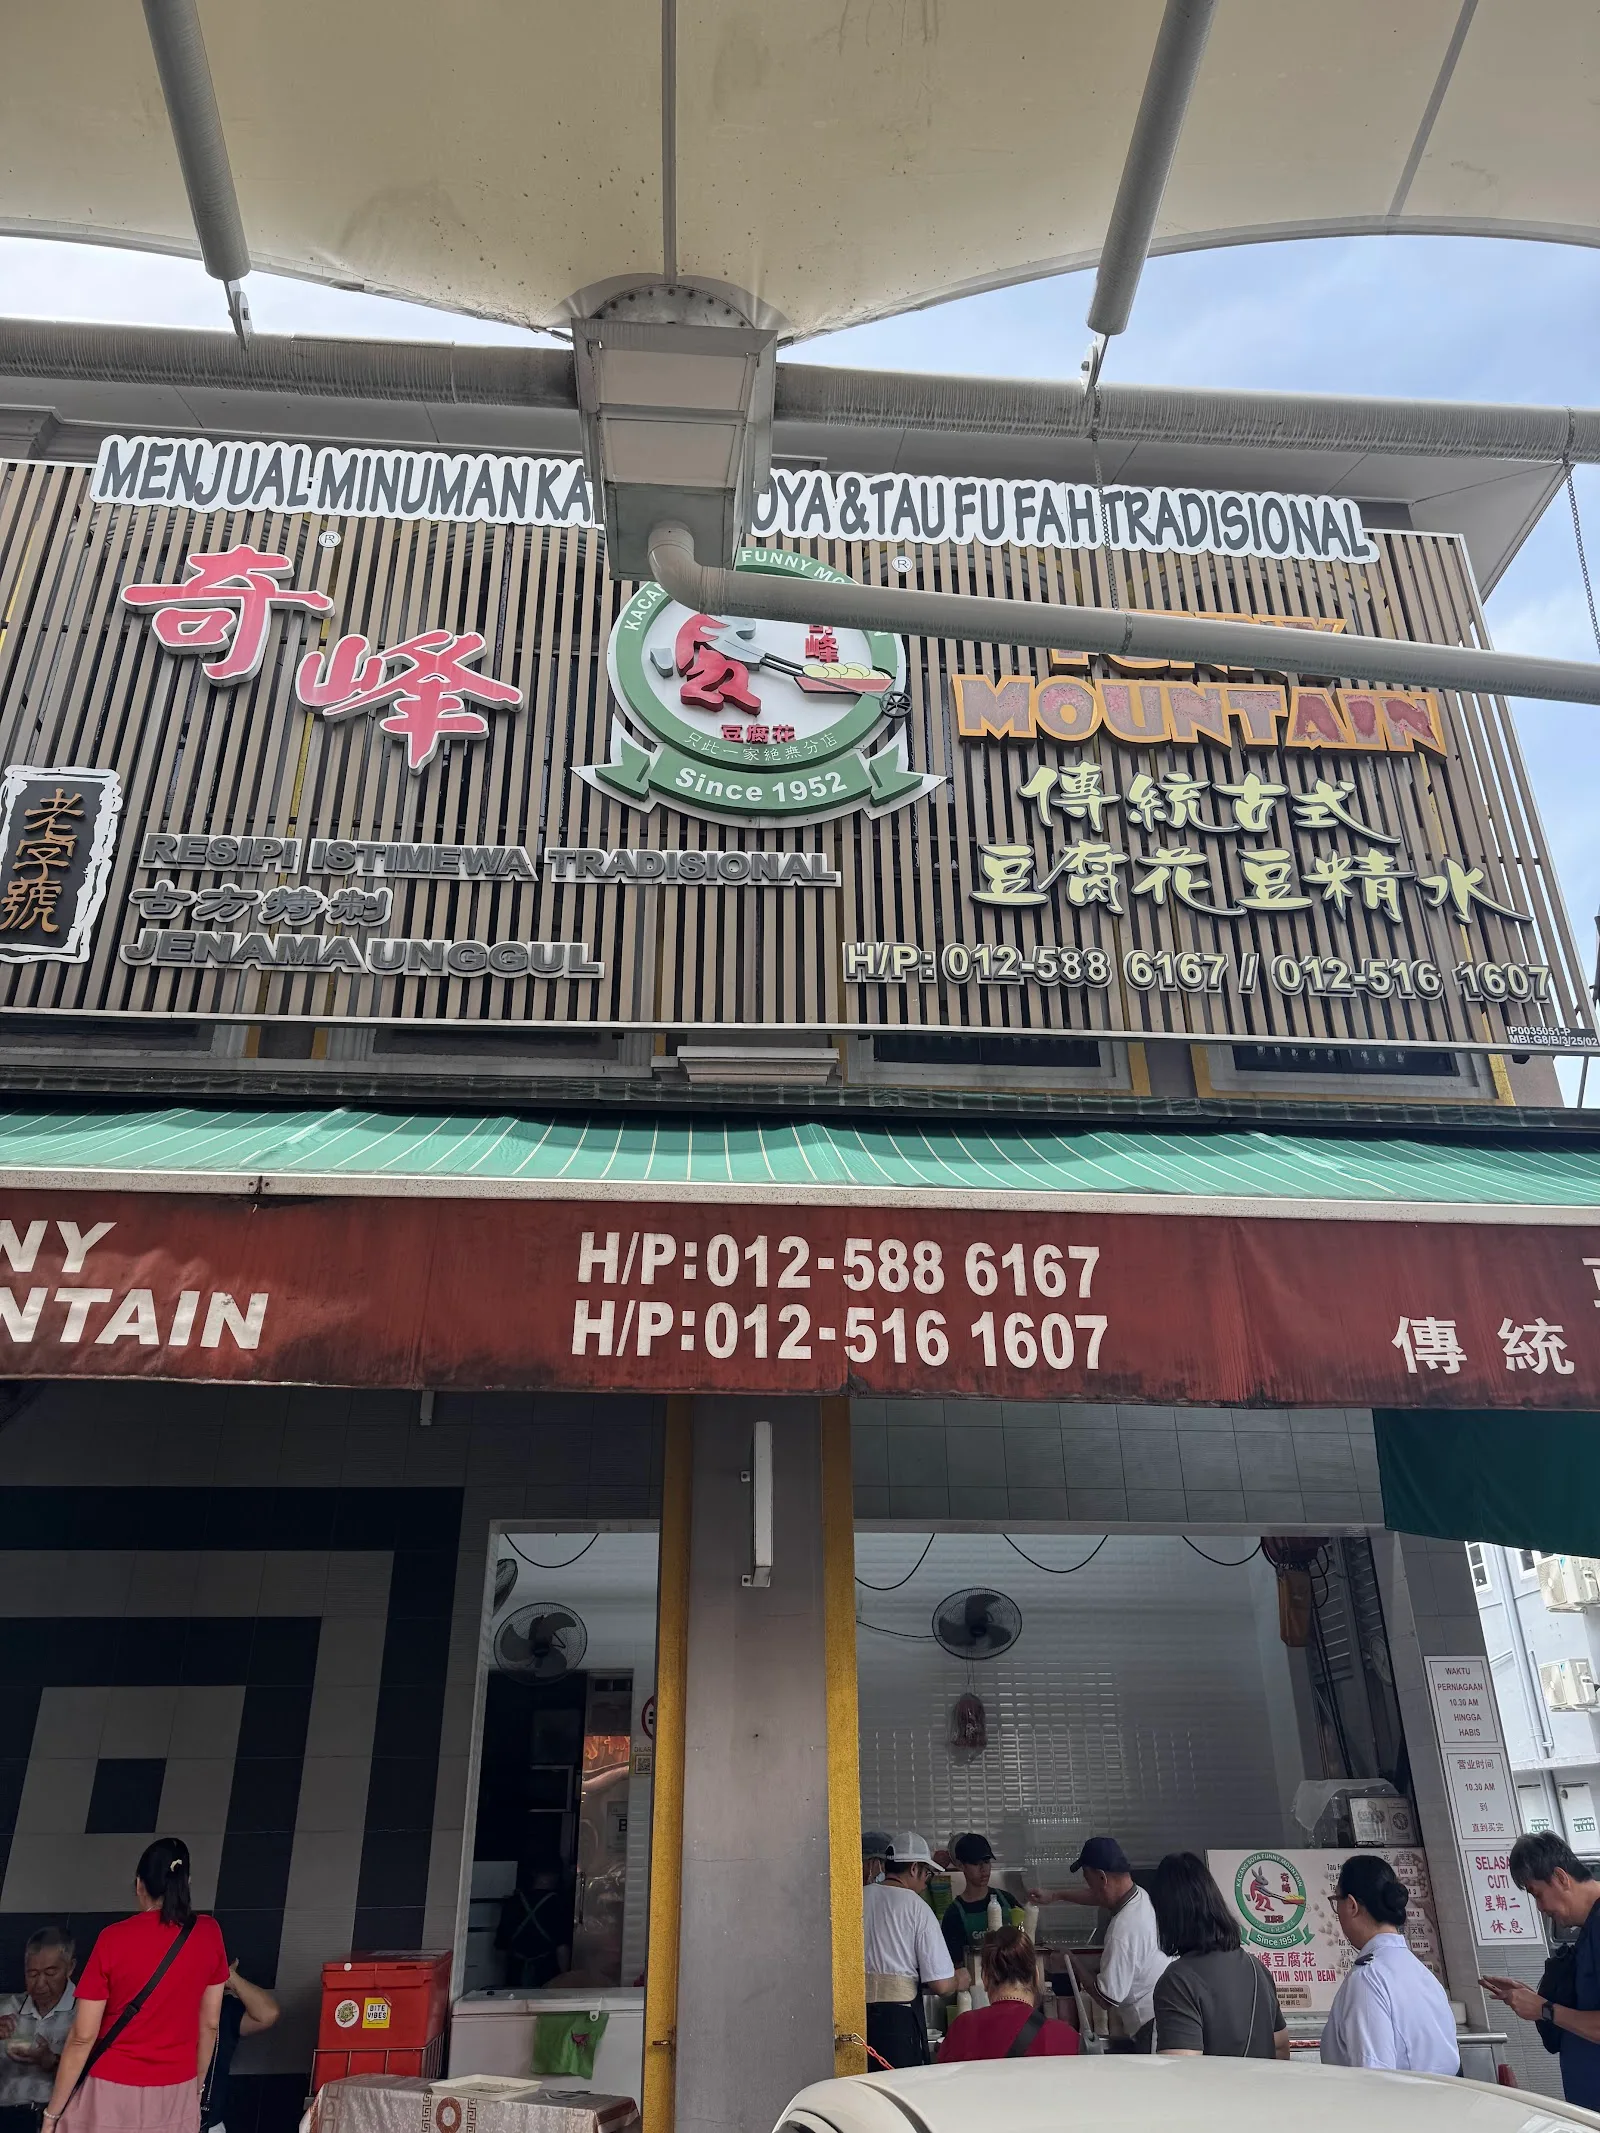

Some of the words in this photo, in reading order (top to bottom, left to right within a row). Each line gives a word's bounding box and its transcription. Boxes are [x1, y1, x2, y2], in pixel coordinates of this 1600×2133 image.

[99, 439, 308, 502] MENJUAL
[316, 452, 529, 519] MINUMAN
[752, 475, 832, 534] OYA
[1102, 490, 1371, 558] TRADISIONAL
[741, 550, 812, 572] FUNNY
[952, 674, 1448, 759] MOUNTAIN
[721, 724, 797, 745] 豆腐花
[675, 767, 763, 802] Since
[772, 771, 848, 802] 1952
[1018, 760, 1402, 844] 傳統古式
[143, 834, 296, 869] RESIPI
[312, 838, 533, 877] ISTIMEWA
[548, 848, 837, 883] TRADISIONAL
[970, 839, 1533, 924] 豆腐花豆精水
[125, 930, 363, 970] JENAMA
[371, 940, 601, 976] UNGGUL
[1128, 951, 1227, 990] 6167
[1278, 956, 1443, 998] 012-516
[1457, 961, 1551, 1002] 1607
[965, 1241, 1101, 1299] 6167
[970, 1310, 1109, 1371] 1607
[1445, 1667, 1471, 1675] WAKTU
[1437, 1683, 1483, 1691] PERNIAGAAN
[1468, 1698, 1479, 1706] AM
[1454, 1713, 1482, 1722] HINGGA
[1459, 1728, 1481, 1737] HABIS
[1457, 1759, 1495, 1770] 营业时间
[1465, 1783, 1483, 1791] 10.30
[1484, 1782, 1496, 1791] AM
[1261, 1853, 1281, 1861] FUNNY
[1475, 1856, 1512, 1870] SELASA
[1487, 1875, 1510, 1888] CUTI
[1484, 1894, 1520, 1912] 星期二
[1490, 1918, 1524, 1934] 休息
[1256, 1934, 1278, 1946] Since
[1279, 1933, 1298, 1946] 1952
[1257, 1951, 1317, 1968] 峰豆腐花
[1294, 1970, 1313, 1981] SOYA
[1316, 1970, 1337, 1981] BEAN
